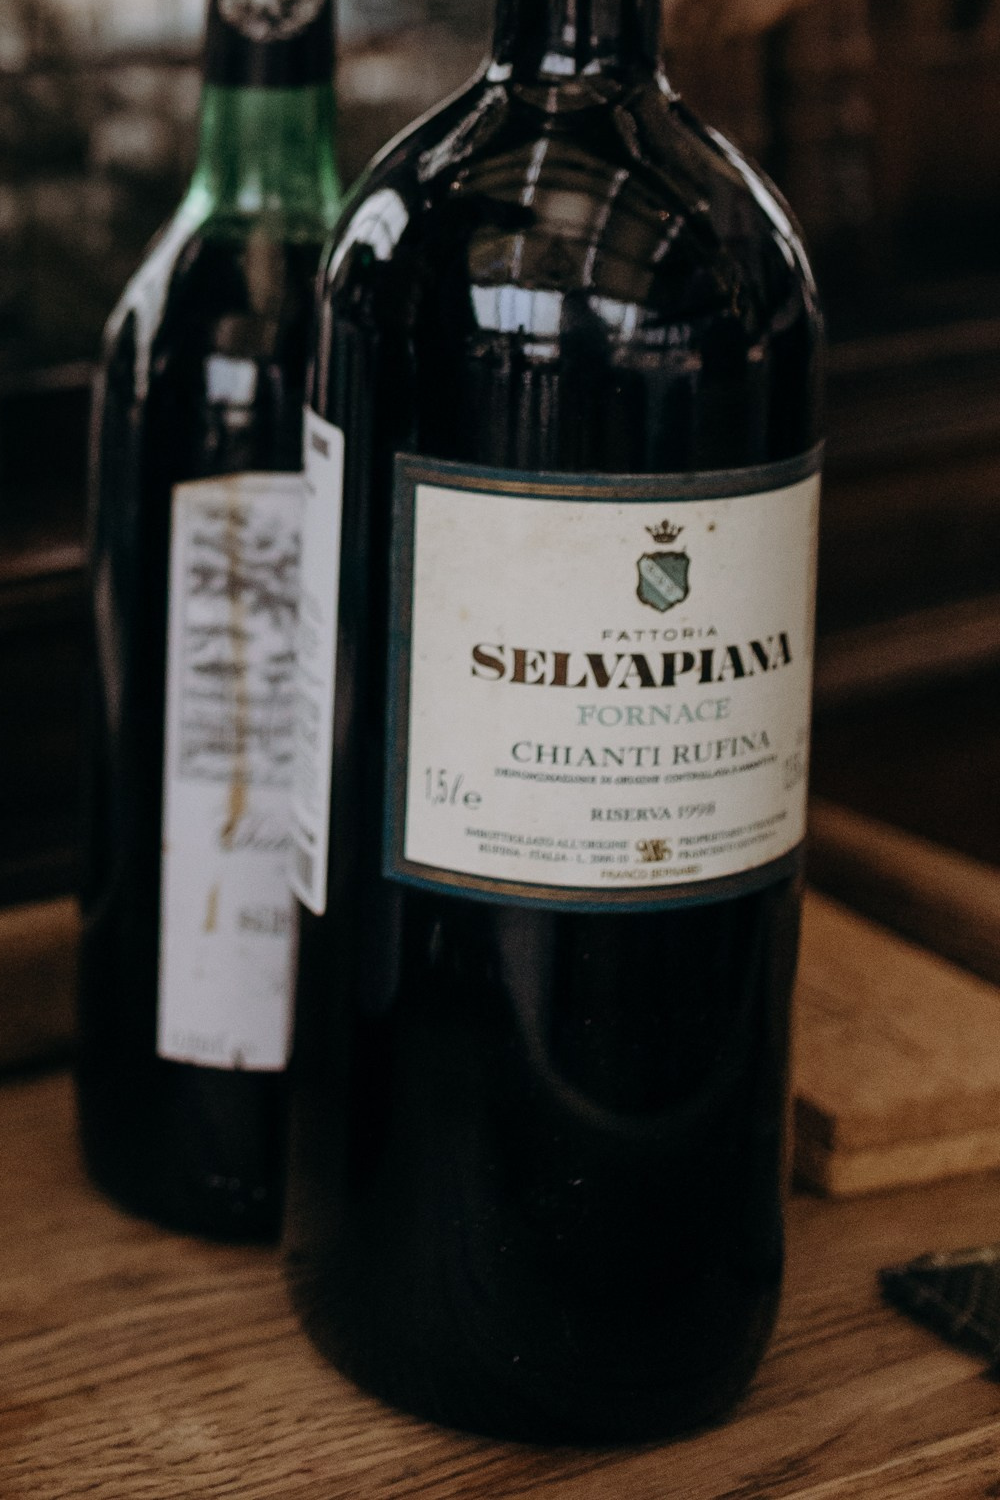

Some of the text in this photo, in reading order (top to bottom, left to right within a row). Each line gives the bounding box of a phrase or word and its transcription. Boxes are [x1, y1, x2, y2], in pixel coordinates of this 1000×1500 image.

[602, 625, 718, 642] FATTORIA
[471, 632, 793, 689] SELVAPIANA
[577, 698, 732, 727] FORNACE
[511, 731, 770, 768] CHIANTI RUFINA
[590, 807, 672, 822] RISERVA
